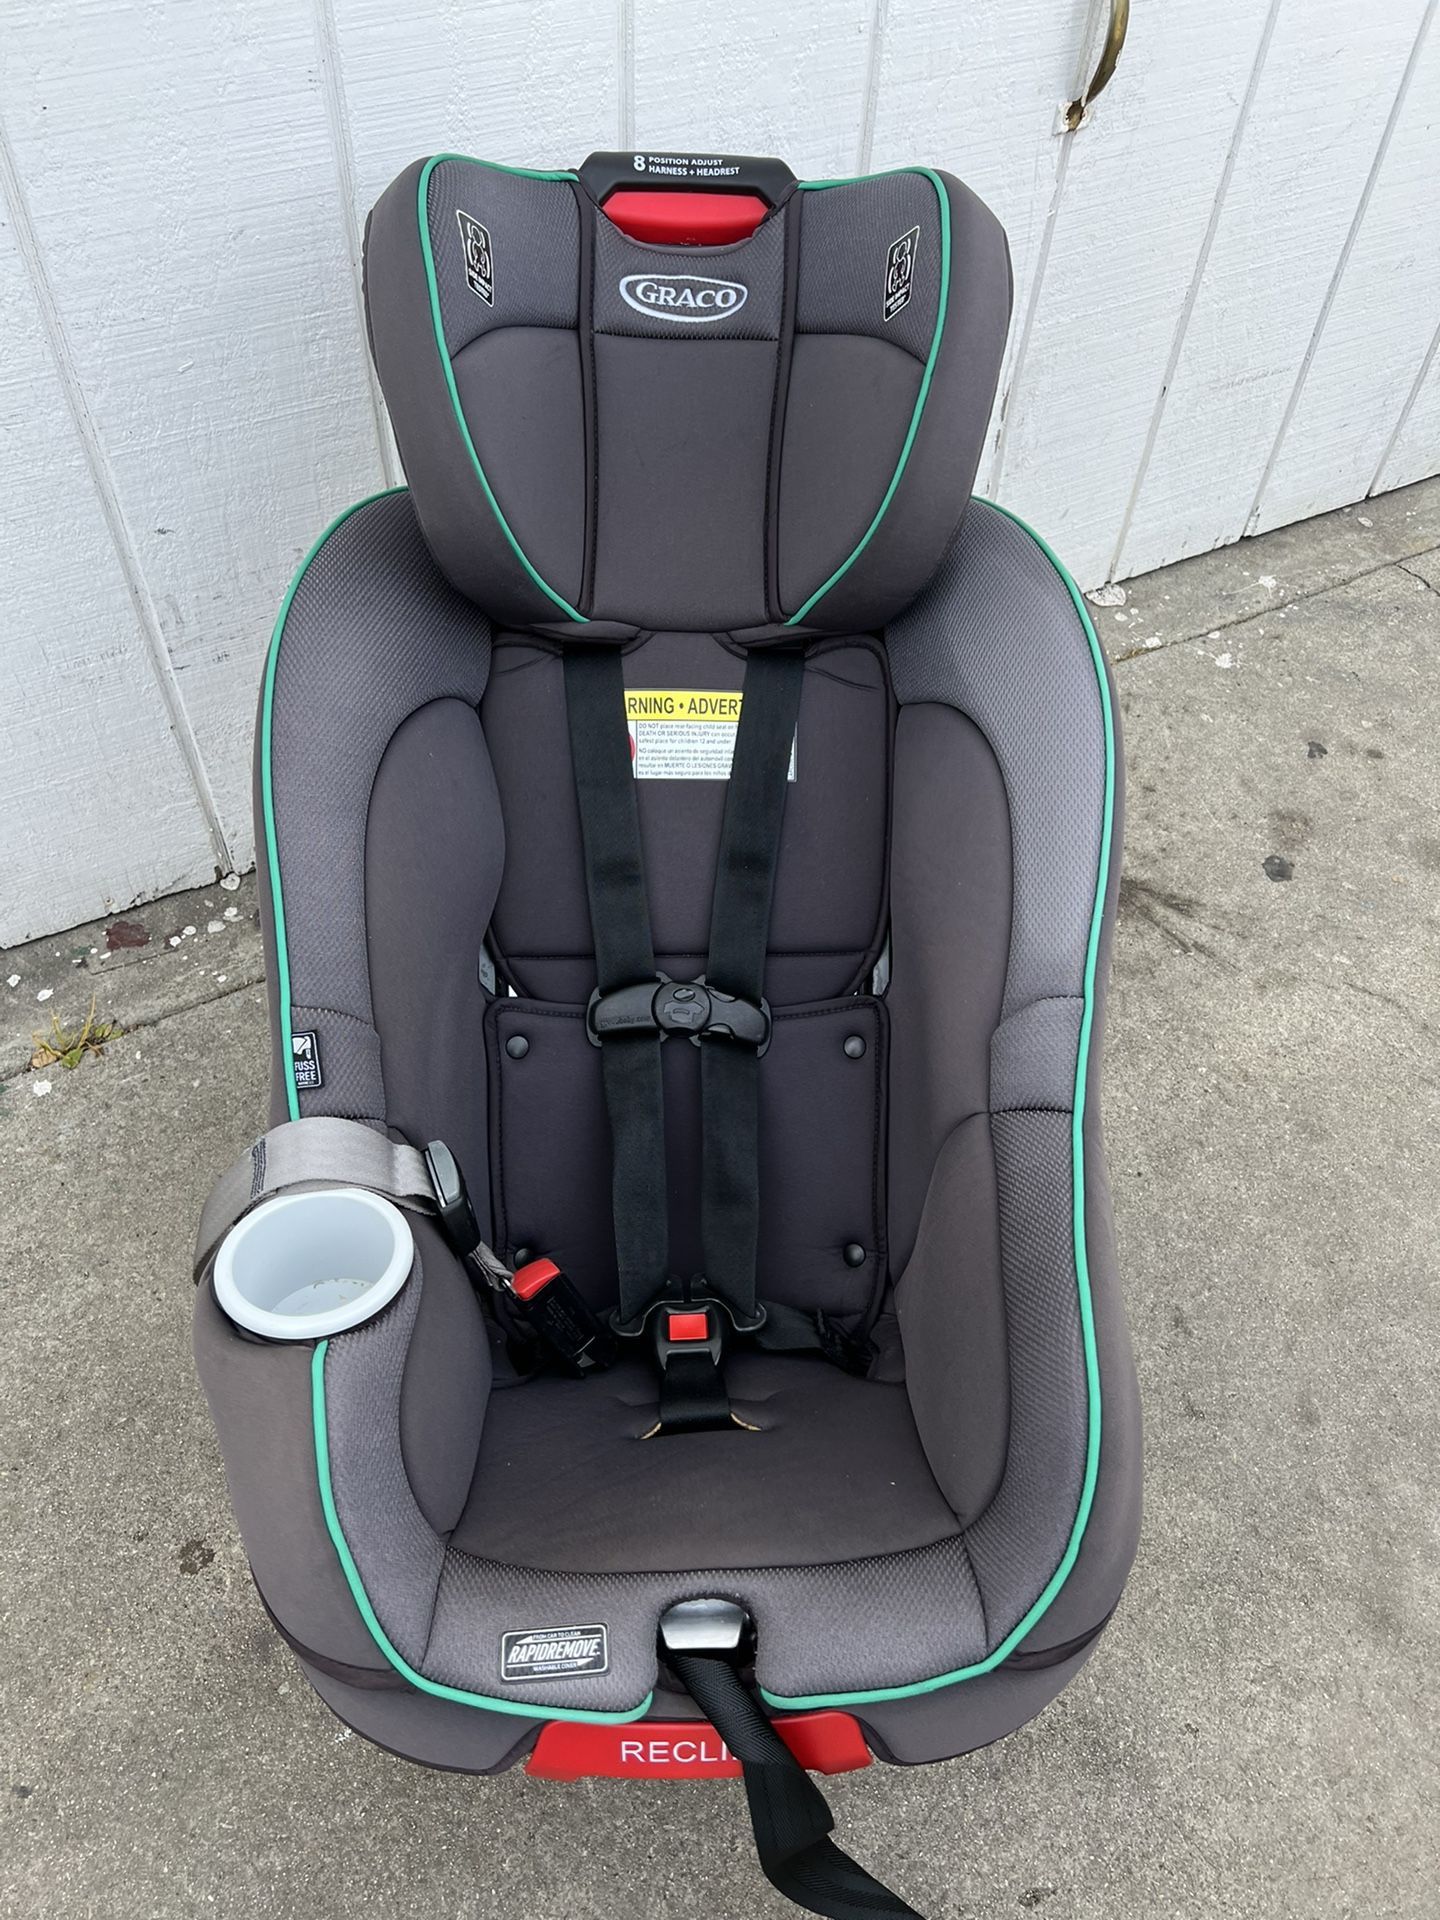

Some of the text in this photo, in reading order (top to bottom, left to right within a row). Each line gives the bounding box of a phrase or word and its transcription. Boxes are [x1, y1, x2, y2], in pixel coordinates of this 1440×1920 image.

[634, 155, 646, 171] 8
[648, 156, 688, 165] POSITION
[648, 165, 688, 176] HARNESS
[696, 167, 740, 176] HEADREST
[636, 281, 737, 308] GRACO
[628, 697, 742, 716] RNING ADVER
[294, 1060, 316, 1071] FUSS
[295, 1070, 317, 1081] FREE
[621, 1741, 738, 1762] RECLI
